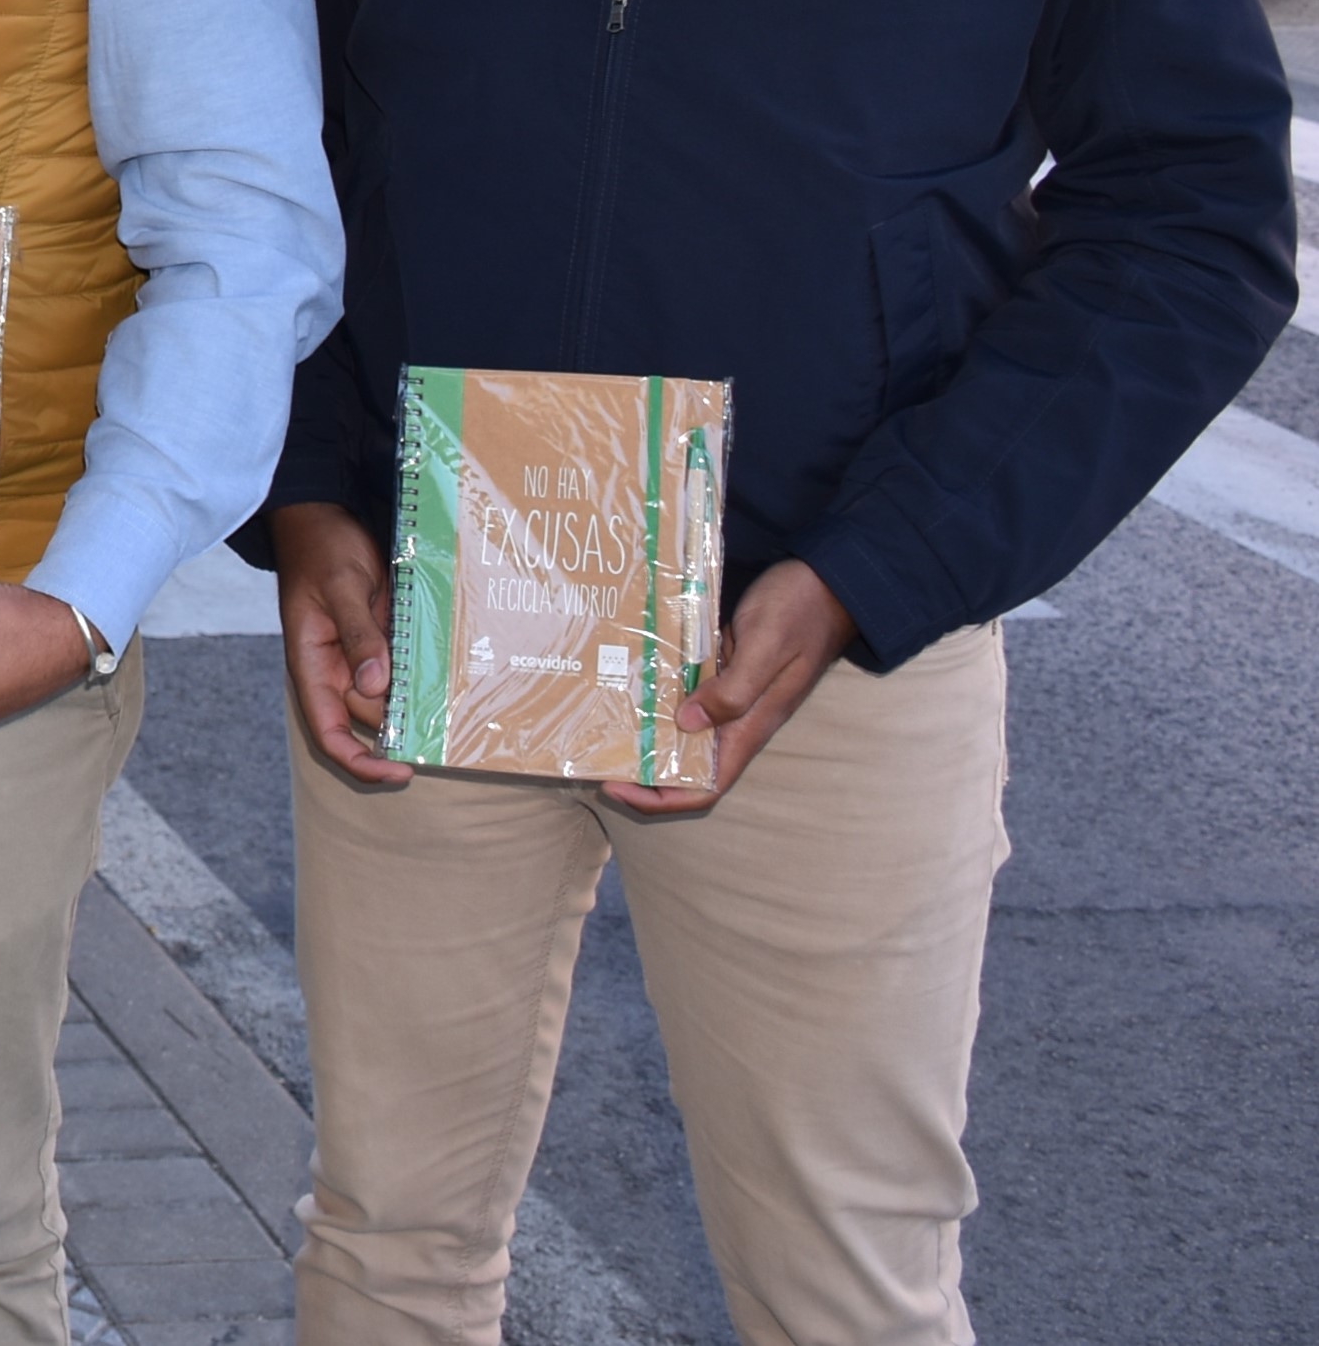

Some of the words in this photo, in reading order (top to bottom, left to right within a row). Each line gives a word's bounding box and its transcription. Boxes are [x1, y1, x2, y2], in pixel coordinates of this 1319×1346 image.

[524, 465, 549, 498] NO
[557, 467, 592, 501] HAY
[481, 506, 626, 575] EXCUSAS
[487, 577, 552, 615] RECICLA
[563, 582, 618, 619] VIDRIO
[509, 654, 583, 672] ecovidrio
